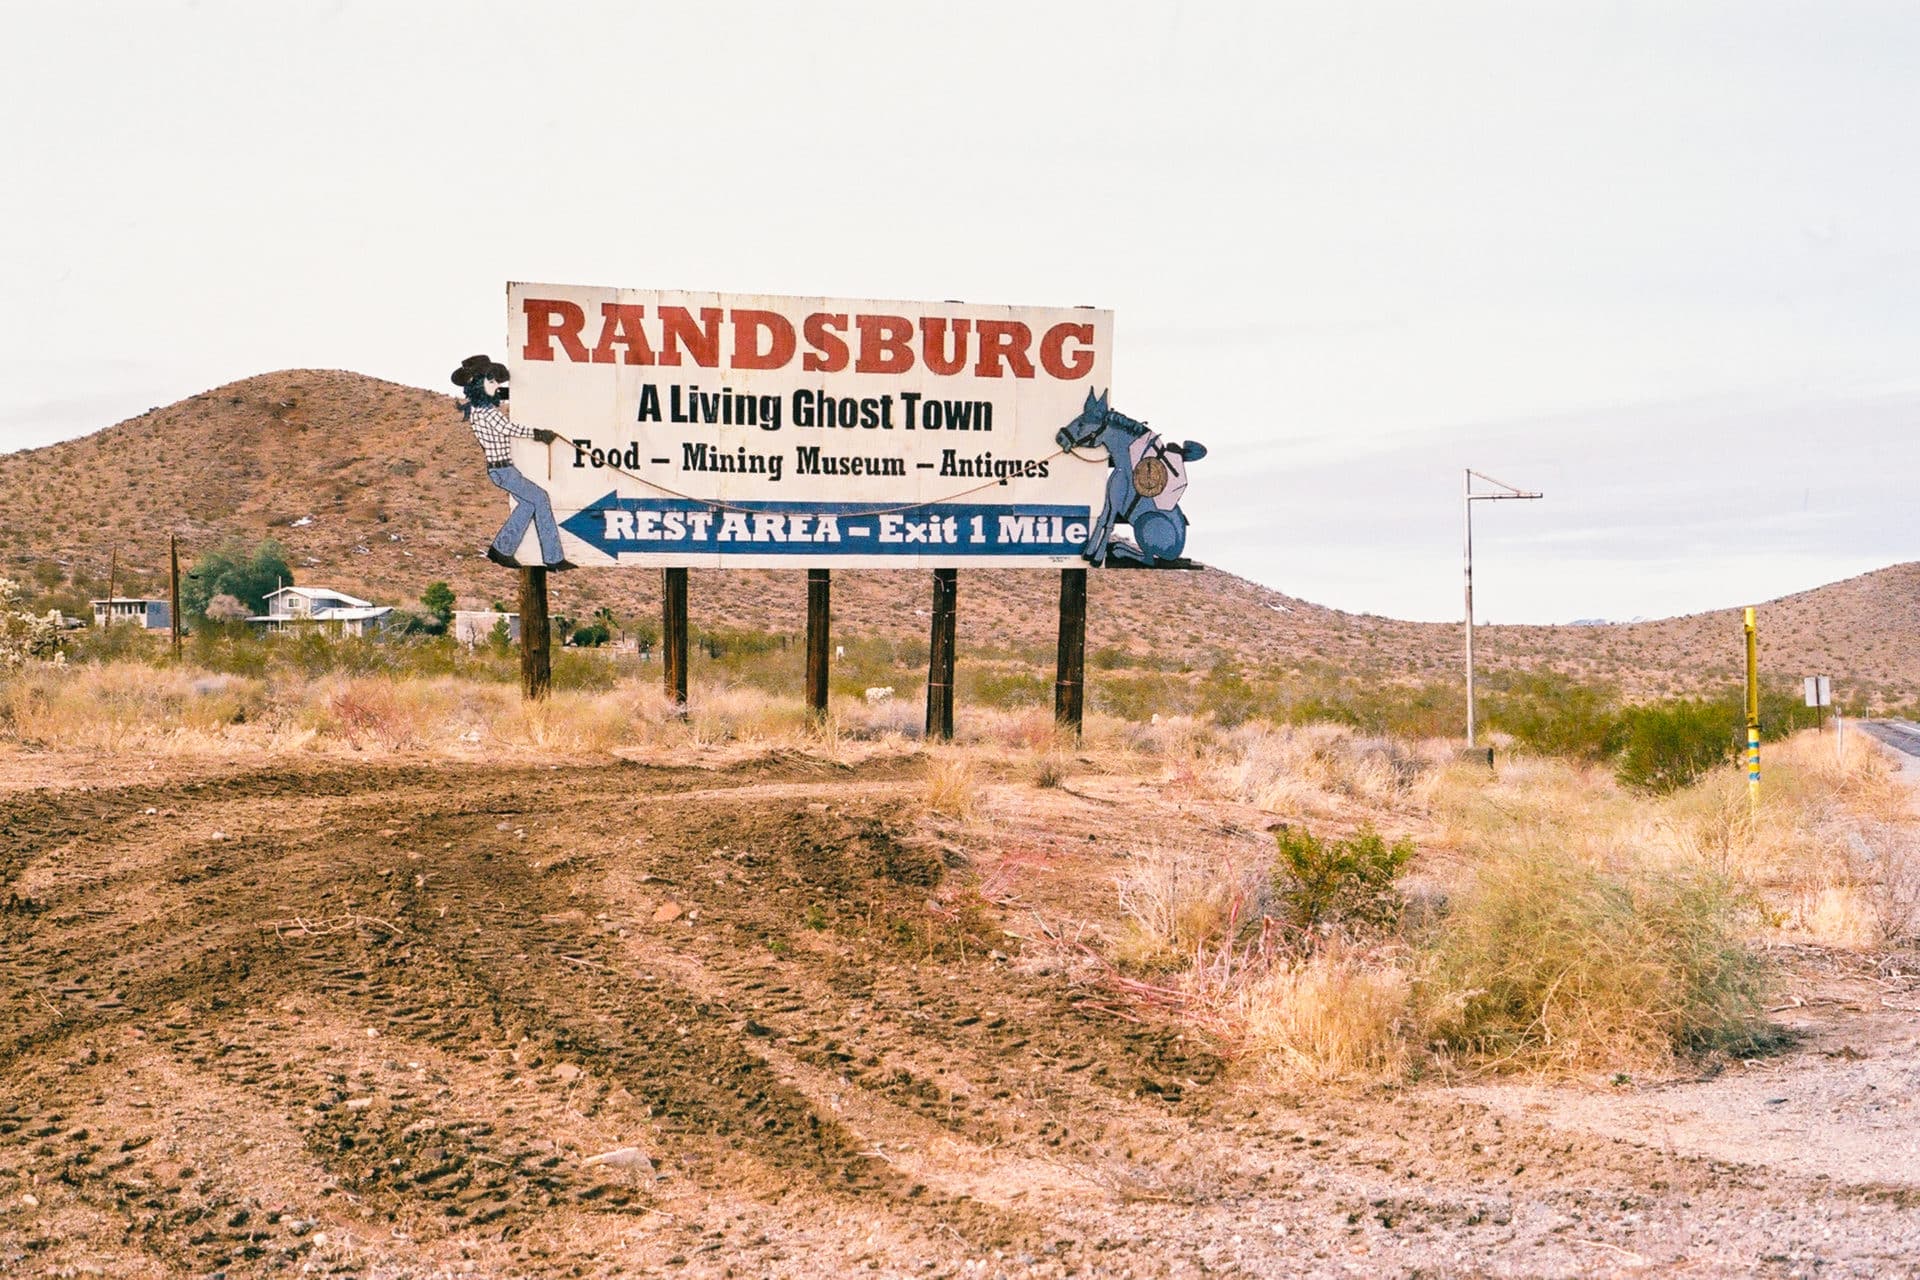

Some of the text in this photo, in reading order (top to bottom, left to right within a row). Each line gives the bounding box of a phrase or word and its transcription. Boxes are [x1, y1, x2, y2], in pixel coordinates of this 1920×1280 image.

[522, 298, 1095, 380] RANDSBURG
[637, 384, 993, 431] A Living Ghost Town
[572, 439, 641, 470] Food
[682, 442, 783, 481] Mining
[796, 446, 906, 476] Museum
[939, 449, 1049, 486] Antiques
[603, 510, 714, 542] REST
[717, 512, 841, 543] AREA
[878, 514, 958, 544] Exit
[970, 516, 987, 544] 1
[997, 515, 1088, 544] Mile
